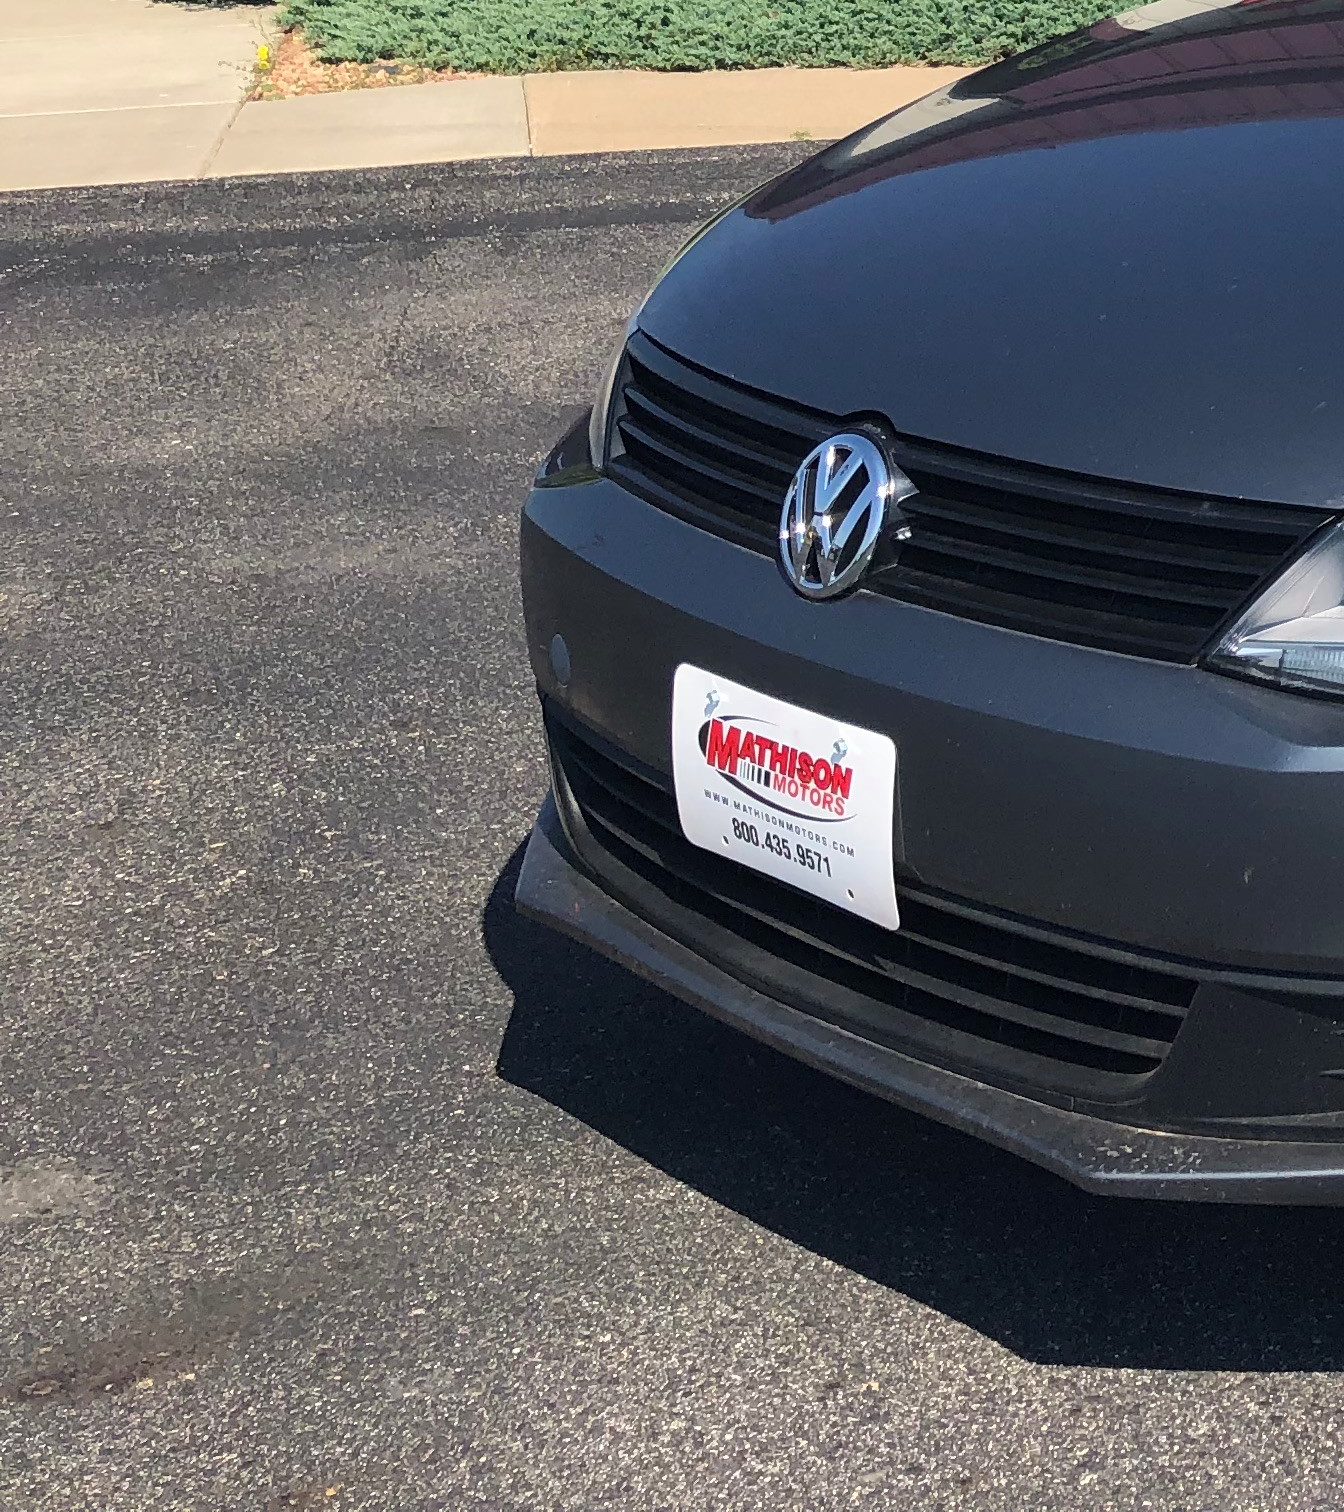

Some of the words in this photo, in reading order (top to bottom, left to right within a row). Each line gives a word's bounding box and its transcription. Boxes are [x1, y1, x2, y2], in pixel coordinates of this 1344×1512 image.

[706, 718, 854, 800] MATHISON
[772, 773, 846, 817] MOTORS
[731, 817, 833, 879] 800.435.9571
